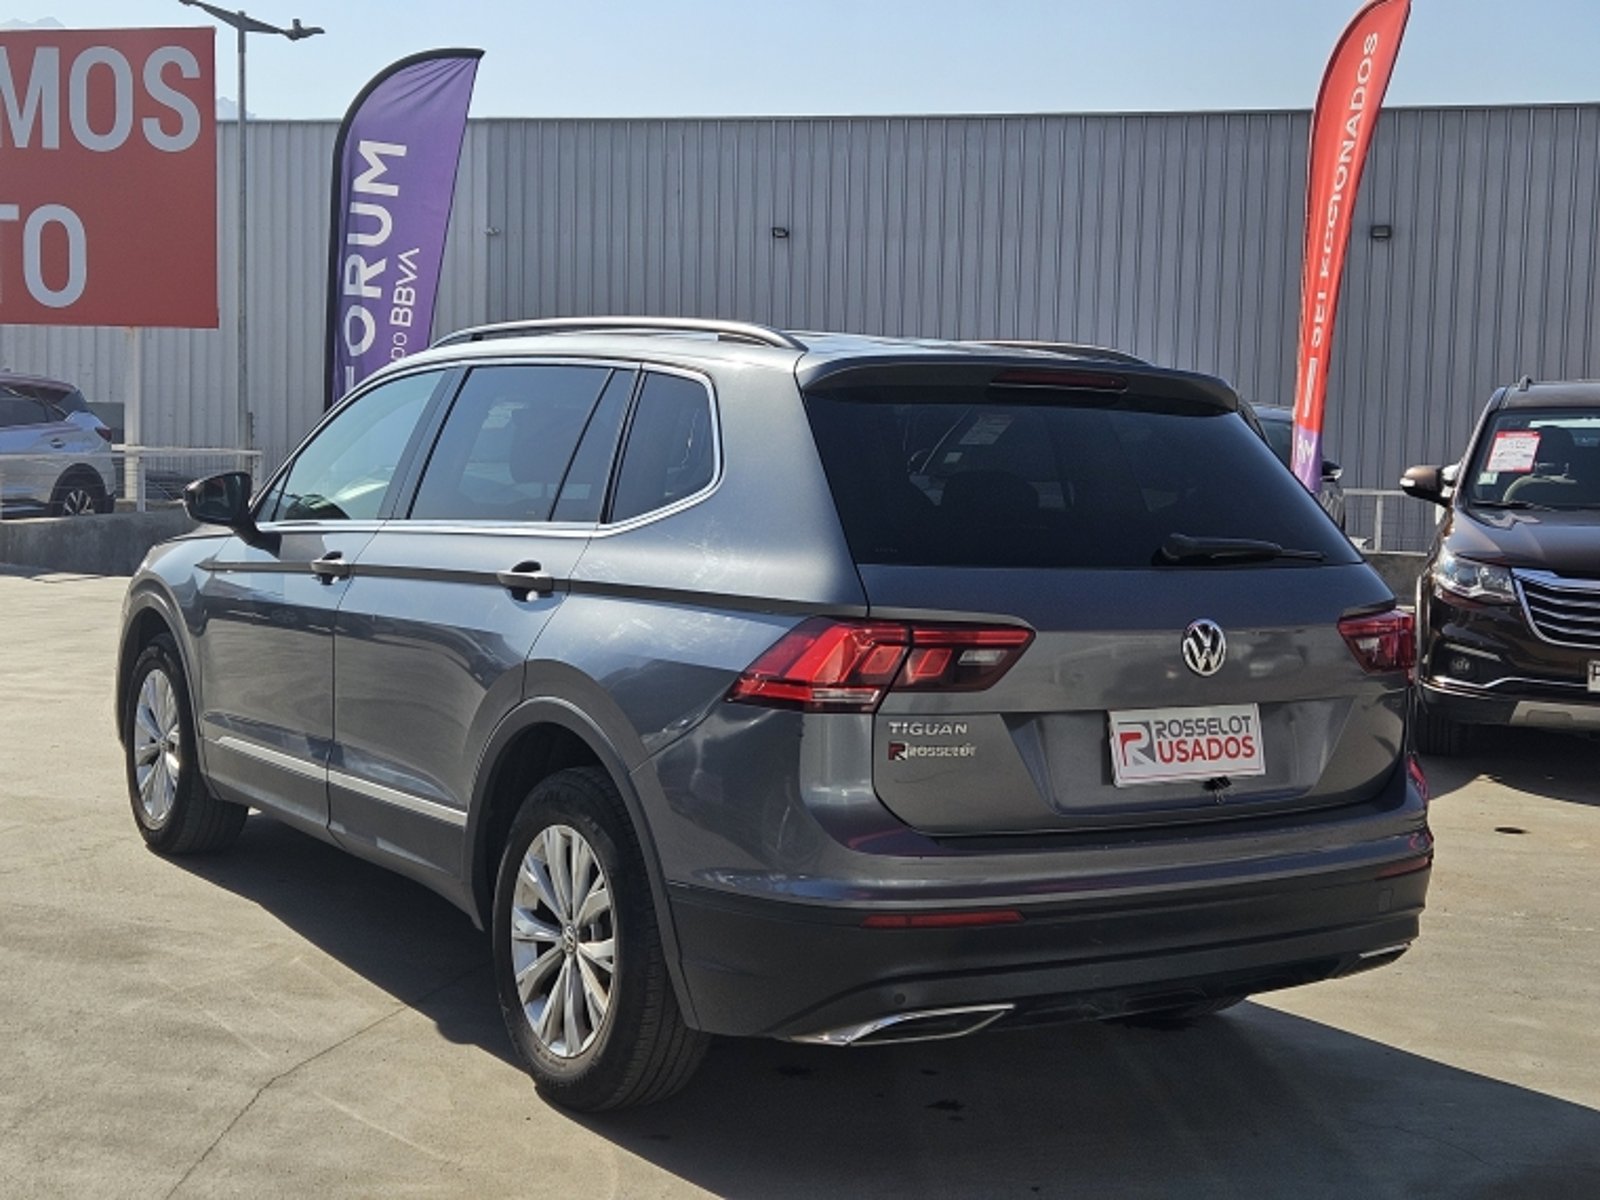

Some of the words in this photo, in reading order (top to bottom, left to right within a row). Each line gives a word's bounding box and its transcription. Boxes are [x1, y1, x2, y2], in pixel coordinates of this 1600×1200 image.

[390, 248, 420, 327] BBVA
[888, 721, 968, 736] TIGUAN
[1154, 715, 1252, 739] ROSSELOT
[1157, 735, 1256, 764] USADOS
